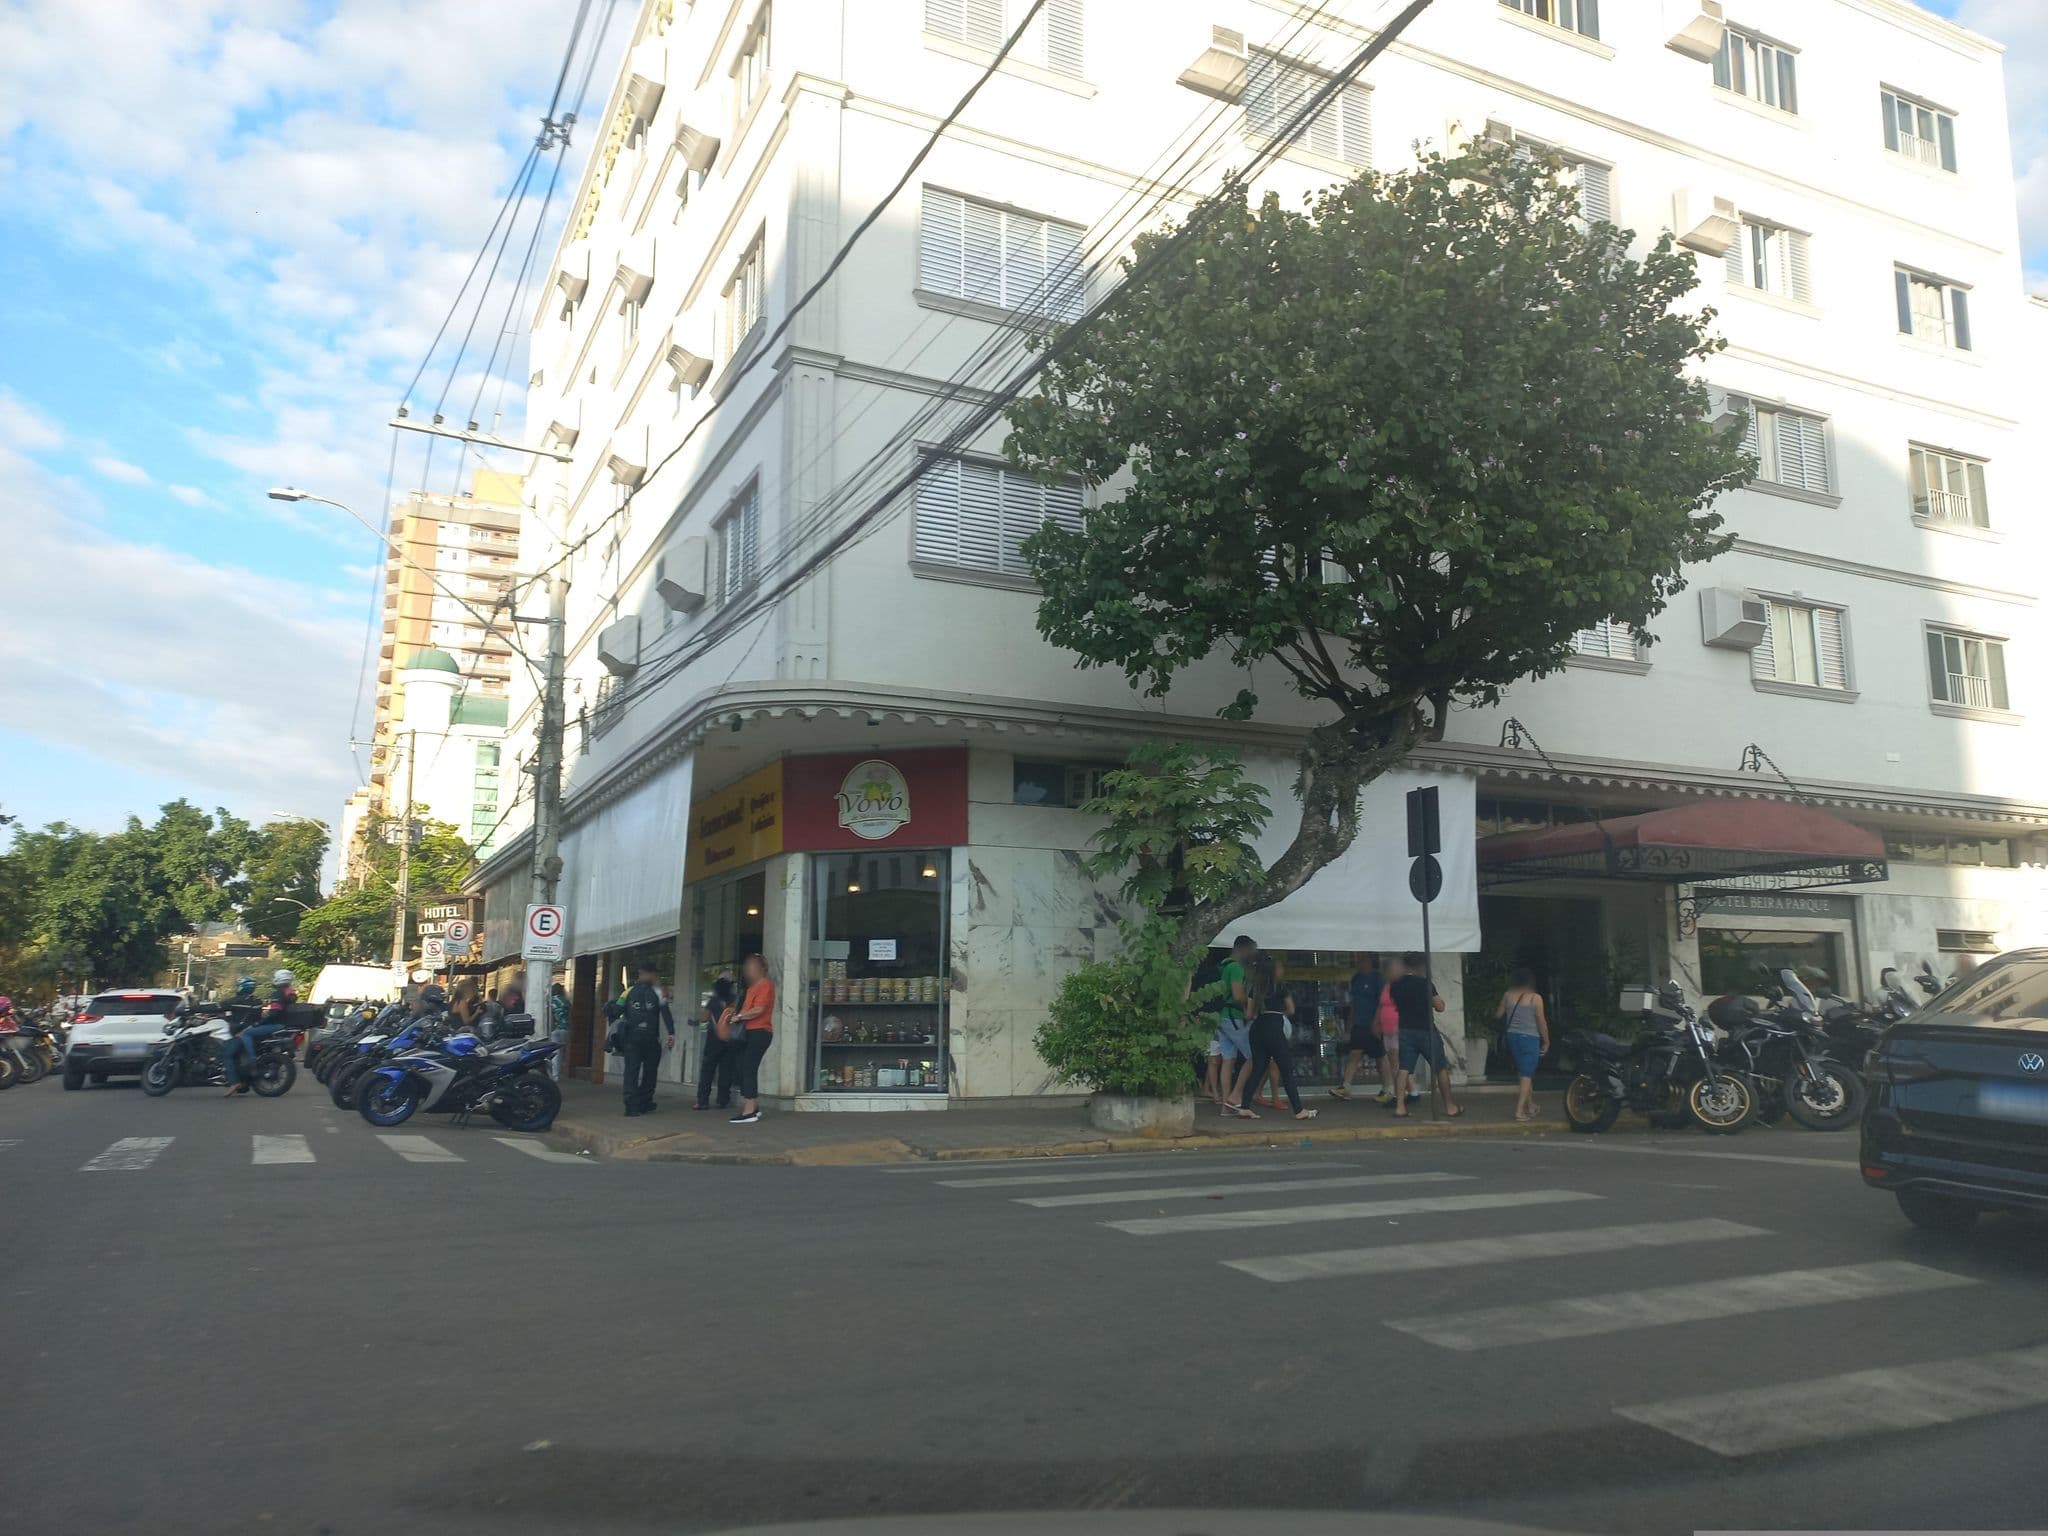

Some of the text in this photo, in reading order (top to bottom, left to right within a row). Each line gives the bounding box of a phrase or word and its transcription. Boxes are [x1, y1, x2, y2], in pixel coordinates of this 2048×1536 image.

[836, 792, 902, 813] Vovó
[424, 906, 461, 919] HOTEL
[1750, 895, 1784, 910] BEIRA
[1785, 897, 1830, 913] PARQUE
[539, 914, 552, 931] E
[454, 925, 464, 938] E
